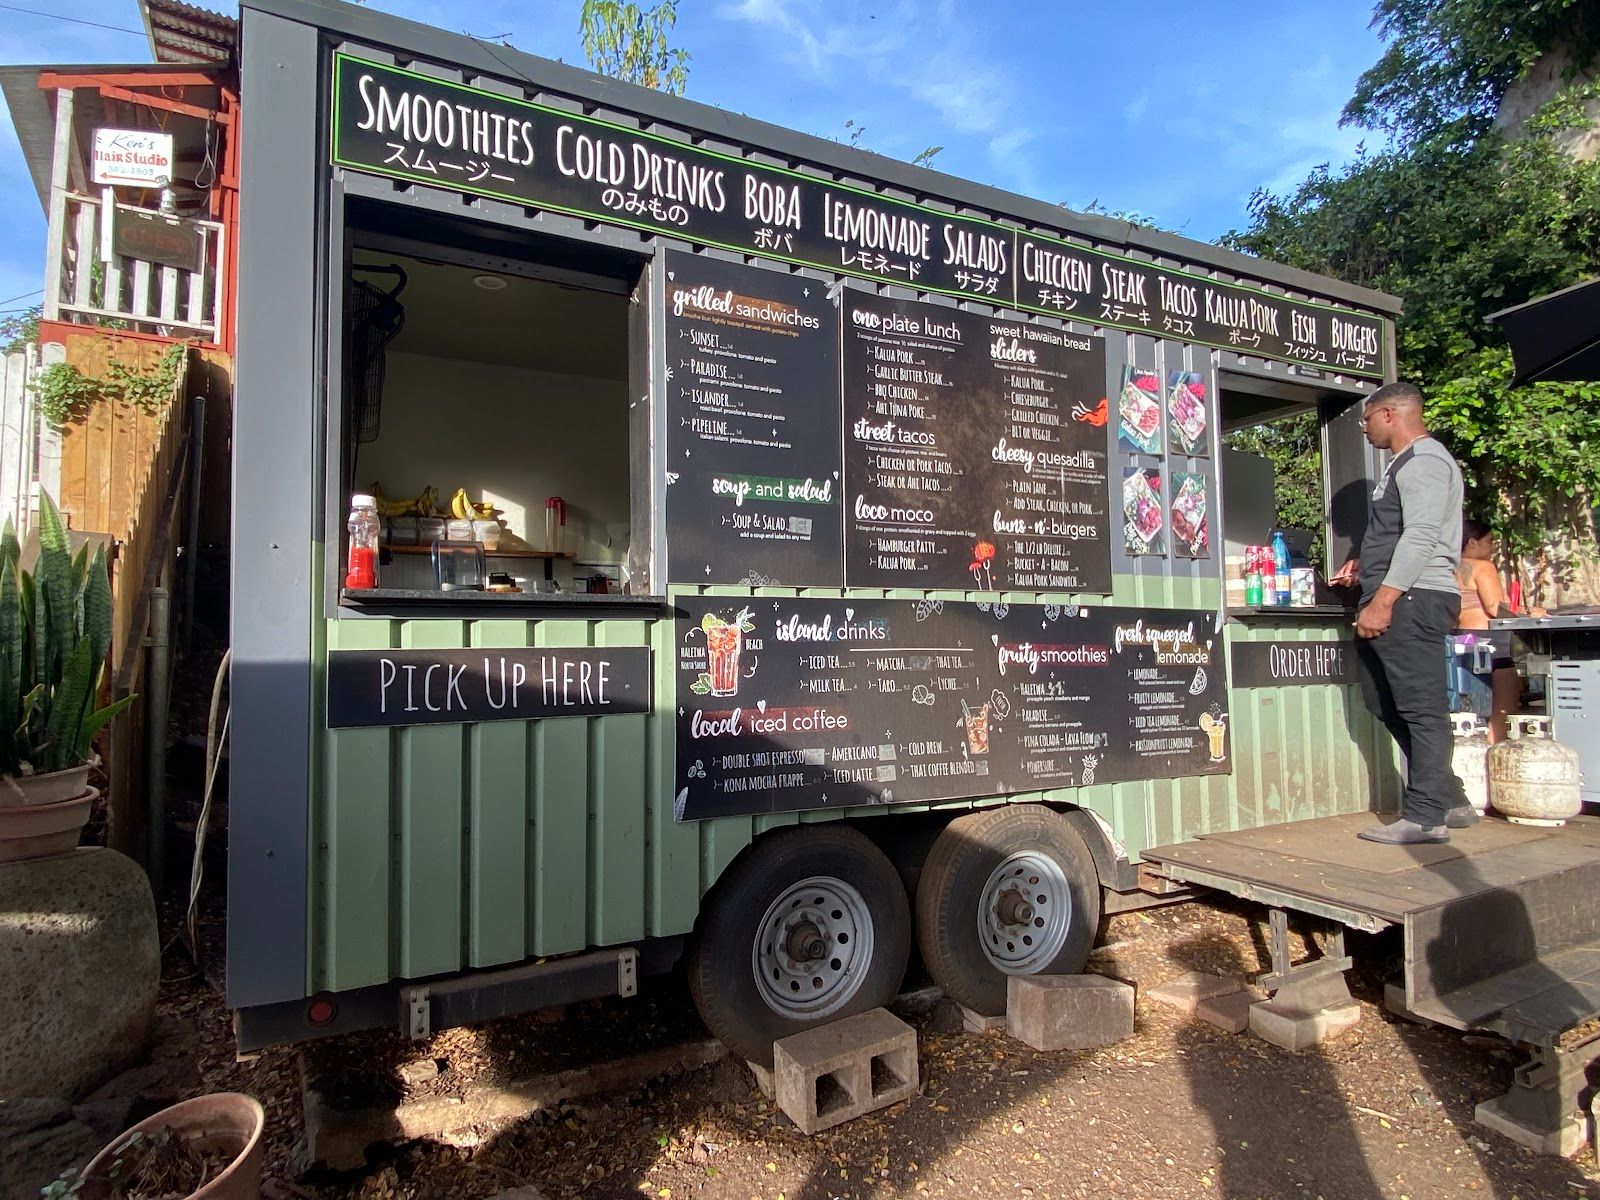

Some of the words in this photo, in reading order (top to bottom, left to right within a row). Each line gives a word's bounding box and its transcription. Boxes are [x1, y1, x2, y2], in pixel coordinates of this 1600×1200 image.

[126, 152, 168, 166] Studio
[357, 74, 534, 166] SMOOTHIES
[556, 125, 626, 185] COLD
[633, 144, 725, 213] DRINKS
[745, 174, 800, 230] BOBA
[824, 192, 930, 260] LEMONADE
[943, 224, 1006, 275] SALADS
[384, 142, 515, 183] スムージー
[601, 189, 689, 225] のみもの
[841, 247, 921, 280] レモネード
[954, 272, 999, 295] サラダ
[673, 286, 733, 316] grilled
[736, 304, 820, 329] sandwiches
[1023, 242, 1091, 295] CHICKEN
[1102, 263, 1147, 306] STEAK
[1158, 276, 1198, 318] TACOS
[1204, 288, 1248, 328] KALUA
[1251, 298, 1278, 337] PORK
[1292, 309, 1317, 344] FISH
[1331, 318, 1377, 356] BURGERS
[853, 310, 881, 328] ono
[882, 313, 919, 335] plate
[925, 317, 960, 340] lunch
[1038, 289, 1078, 311] チキン
[1100, 304, 1151, 326] ステーキ
[1162, 316, 1194, 336] タコス
[1229, 331, 1261, 348] ポーク
[1284, 342, 1327, 363] フィッシュ
[1336, 351, 1374, 368] バーガー
[990, 325, 1020, 337] sweet
[1023, 326, 1062, 346] hawaiian
[1064, 335, 1090, 351] bread
[874, 346, 895, 362] KALUA
[897, 349, 913, 364] PORK
[990, 337, 1037, 363] sliders
[875, 365, 898, 380] GARLIC
[900, 368, 923, 383] BUTTER
[924, 370, 943, 385] STEAK
[1011, 375, 1030, 389] KALUA
[1031, 377, 1044, 391] PORK
[875, 384, 886, 400] BBQ
[888, 384, 917, 400] CHICKEN
[876, 401, 887, 415] AHI
[909, 404, 924, 419] POKE
[854, 418, 895, 442] street
[898, 428, 936, 445] tacos
[992, 438, 1034, 473] cheesy
[1037, 451, 1094, 469] quesadilla
[876, 455, 905, 470] CHICKEN
[907, 460, 915, 470] OR
[917, 460, 933, 473] PORK
[934, 460, 952, 475] TACOS
[877, 473, 896, 488] STEAK
[898, 478, 905, 489] OR
[908, 476, 919, 490] AHI
[922, 476, 940, 491] TACOS
[1013, 480, 1031, 494] PLAIN
[712, 478, 751, 506] soup
[756, 481, 783, 498] and
[788, 478, 831, 502] salad
[855, 495, 888, 520] loco
[891, 508, 933, 522] moco
[1014, 497, 1025, 509] ADD
[1079, 501, 1092, 515] PORK
[732, 513, 750, 528] SOUP
[754, 514, 760, 527] &
[1051, 518, 1096, 540] burgers
[878, 538, 914, 553] HAMBURGER
[917, 539, 935, 554] PATTY
[1026, 542, 1035, 555] 1/2
[878, 556, 898, 569] KALUA
[900, 557, 916, 570] PORK
[776, 614, 832, 642] island
[837, 621, 885, 640] drinks
[1115, 619, 1143, 654] fresh
[1146, 621, 1193, 653] squeezed
[746, 639, 763, 651] BEACH
[809, 655, 825, 669] ICED
[936, 656, 950, 668] THAI
[998, 642, 1040, 676] fruity
[1041, 645, 1106, 663] smoothies
[1157, 648, 1208, 664] lemonade
[1270, 645, 1312, 678] ORDER
[1316, 645, 1344, 676] HERE
[379, 658, 468, 713] PICK
[484, 657, 525, 709] UP
[541, 656, 610, 707] HERE
[809, 679, 830, 693] MILK
[691, 707, 742, 739] local
[750, 711, 787, 733] iced
[793, 709, 848, 730] coffee
[909, 742, 925, 756] COLD
[926, 741, 942, 754] BREW
[723, 755, 750, 769] DOUBLE
[752, 752, 770, 767] SHOT
[772, 751, 805, 766] ESPRESSO
[833, 769, 850, 783] ICED
[911, 764, 927, 777] THAI
[928, 762, 949, 776] COFFEE
[724, 778, 747, 793] KONA
[749, 775, 776, 791] MOCHA
